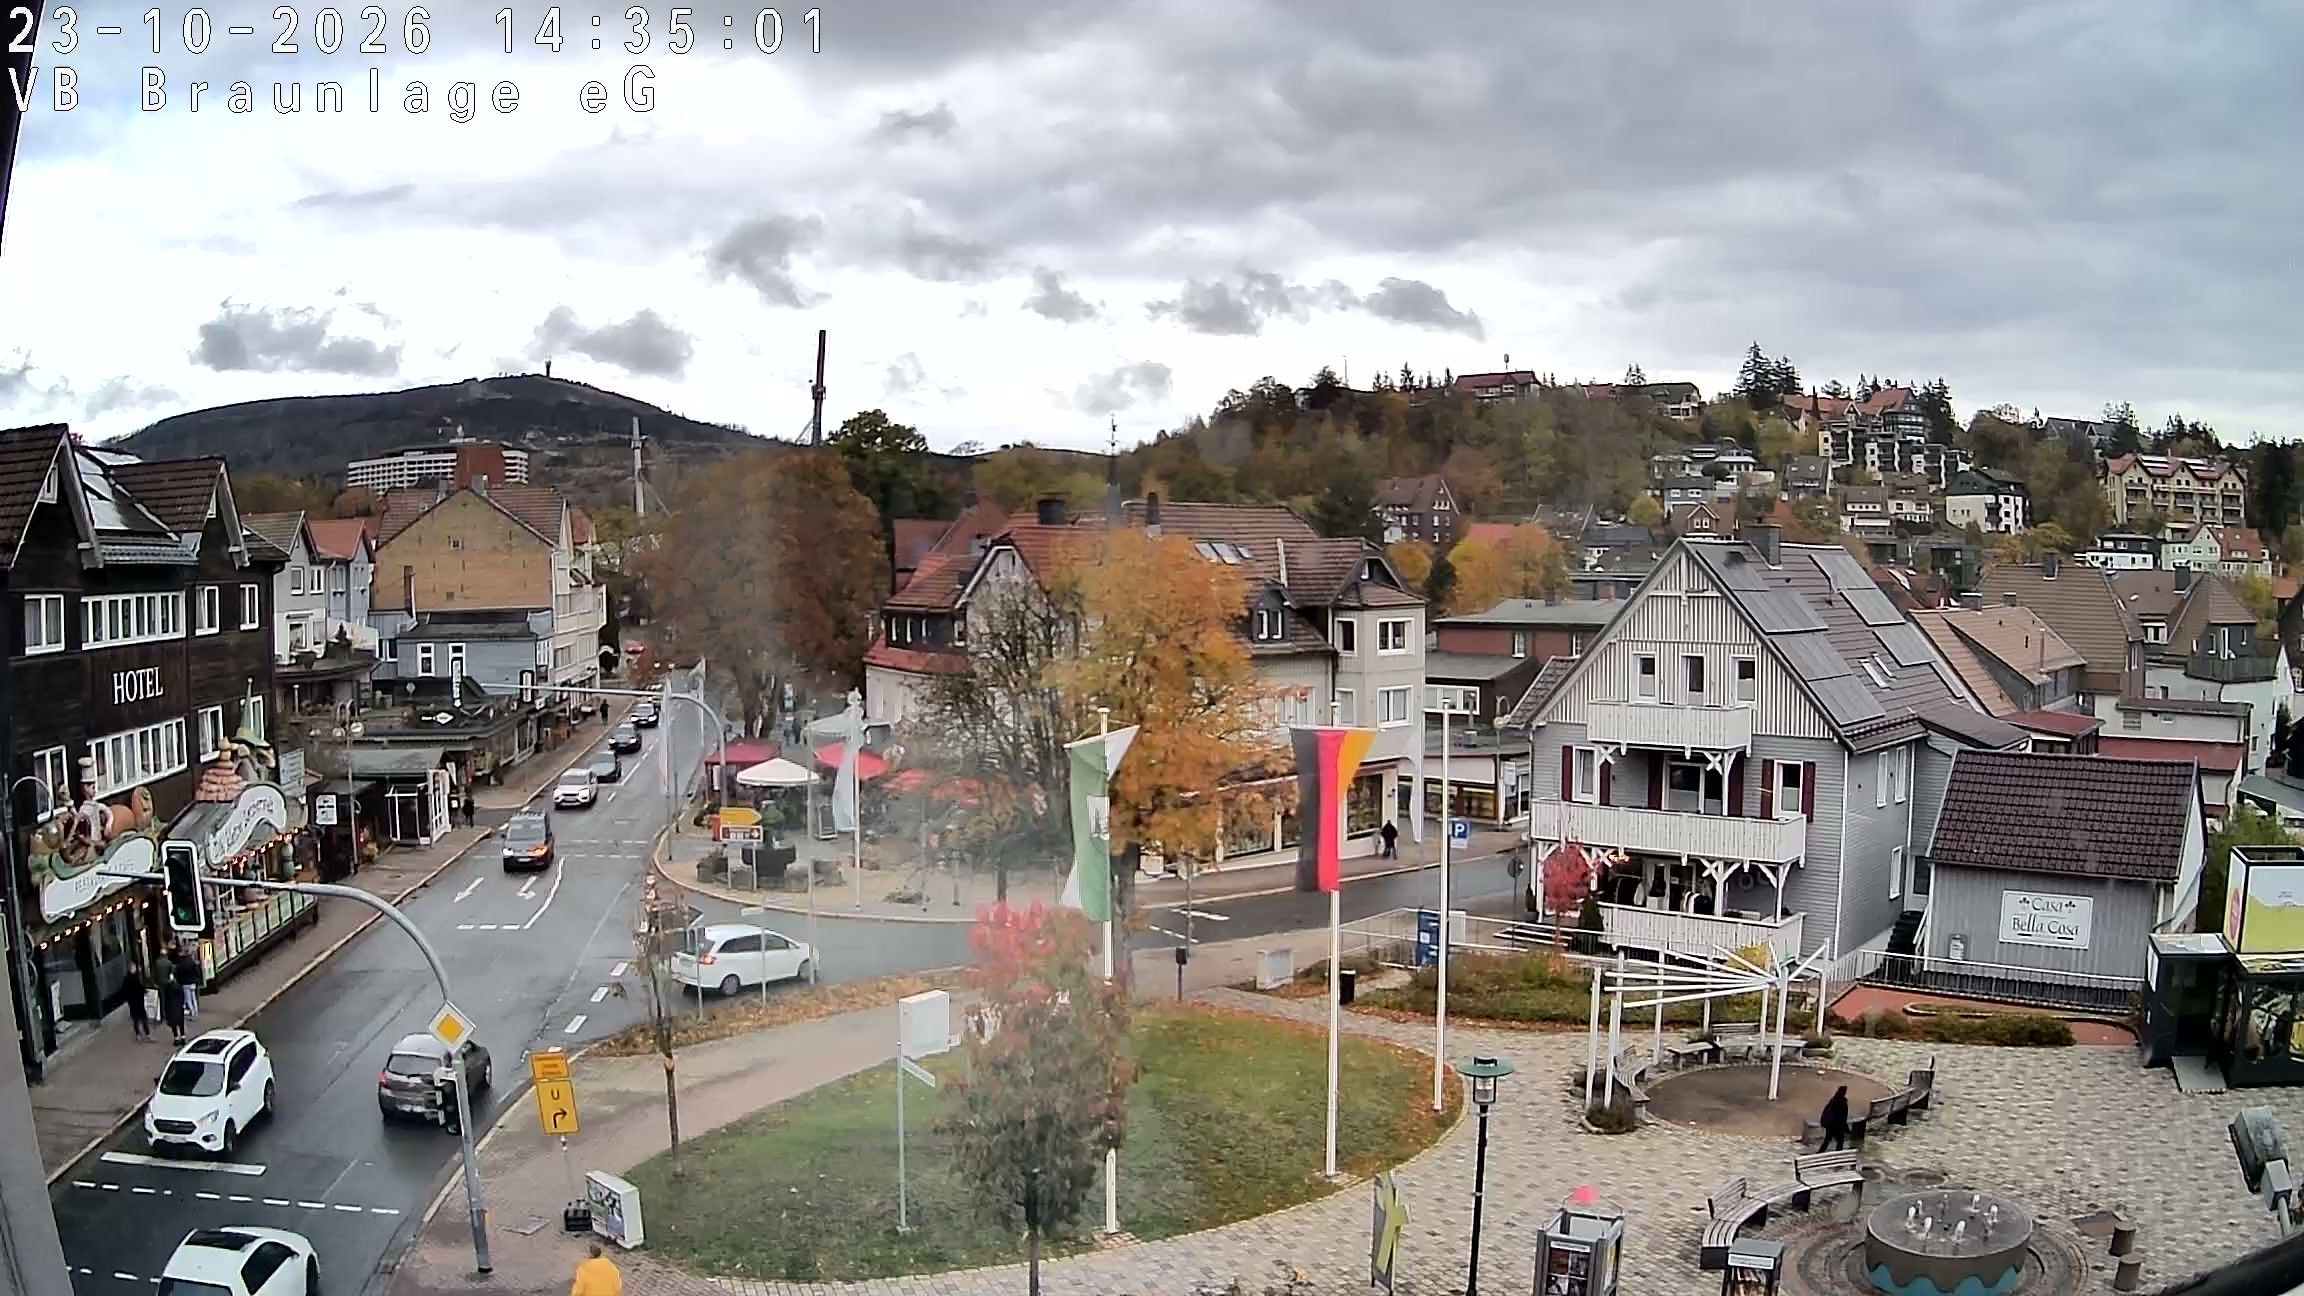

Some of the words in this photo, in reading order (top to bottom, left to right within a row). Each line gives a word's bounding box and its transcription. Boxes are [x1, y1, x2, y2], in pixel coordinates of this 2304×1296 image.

[113, 666, 164, 705] HOTEL
[2031, 897, 2064, 912] Casa
[2012, 913, 2044, 932] Bella
[550, 1088, 560, 1101] U
